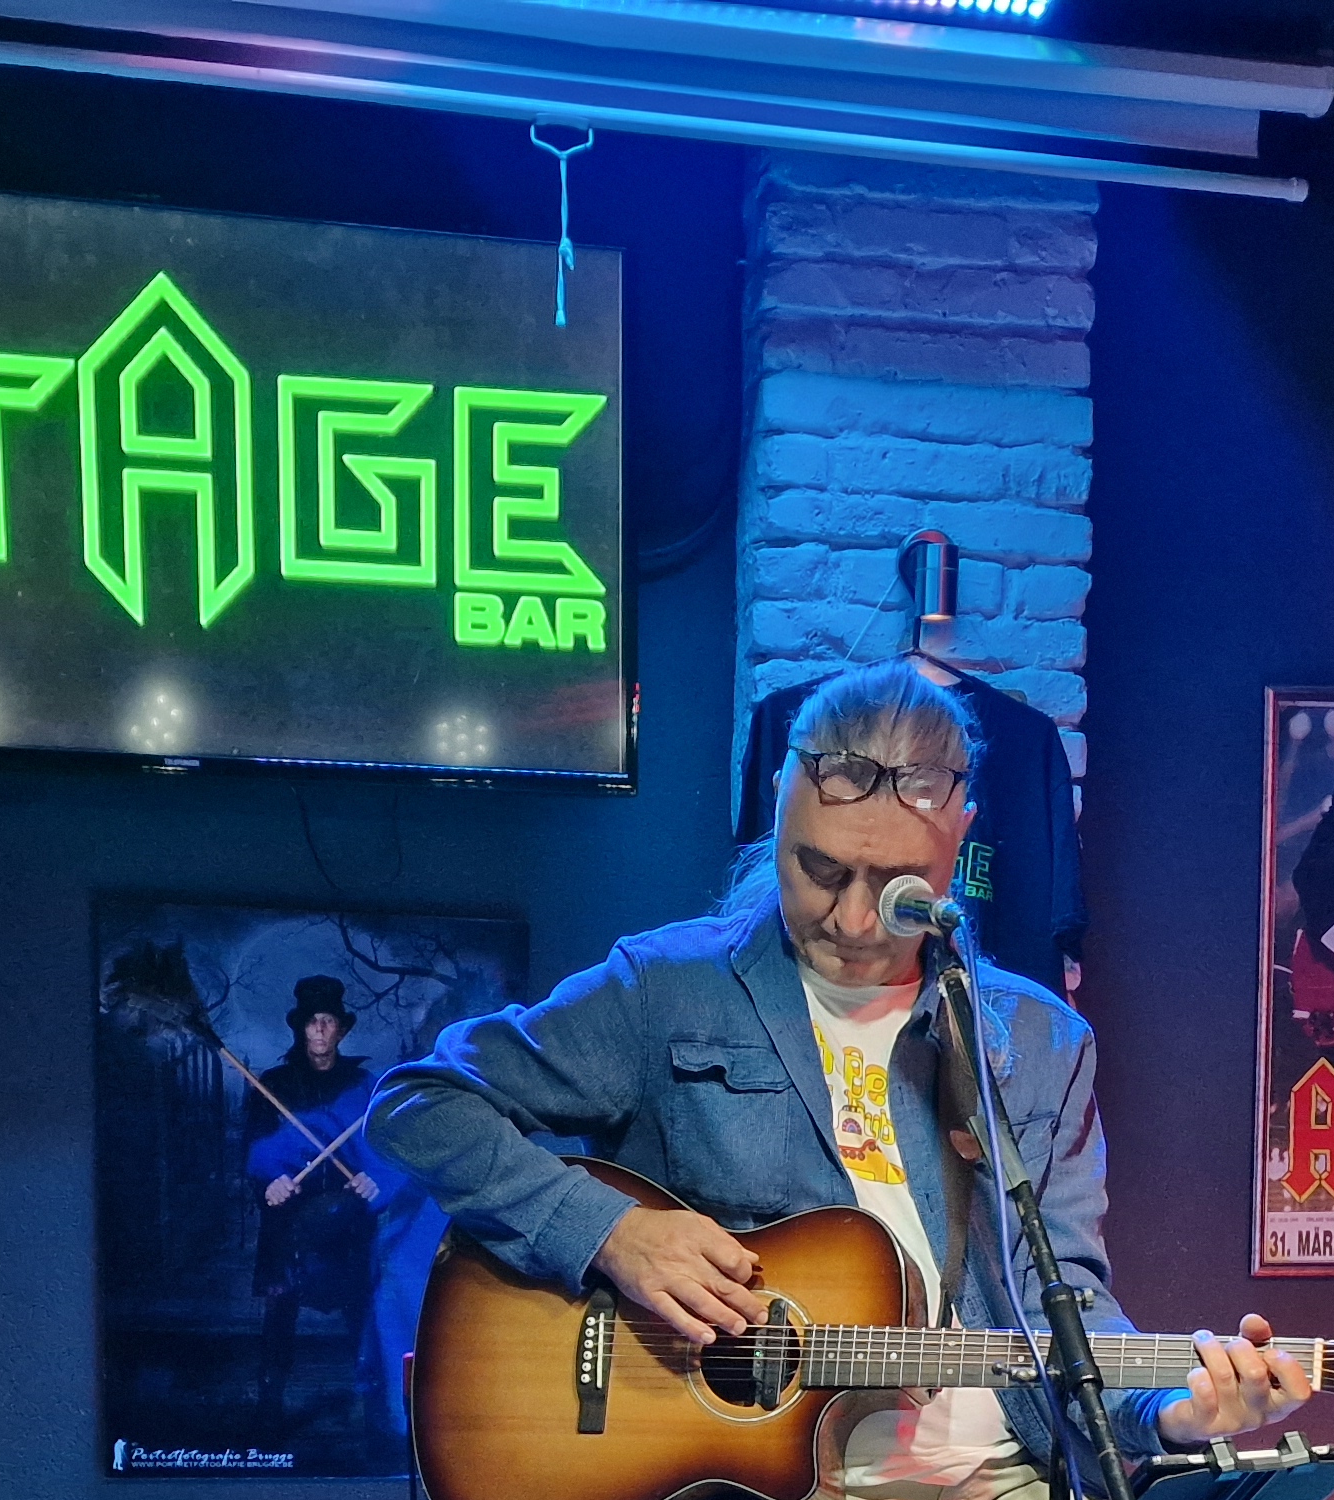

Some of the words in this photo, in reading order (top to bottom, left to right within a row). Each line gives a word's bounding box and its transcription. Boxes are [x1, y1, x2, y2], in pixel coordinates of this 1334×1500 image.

[453, 591, 606, 652] BAR
[965, 885, 993, 902] BAR
[1269, 1230, 1291, 1258] 31.
